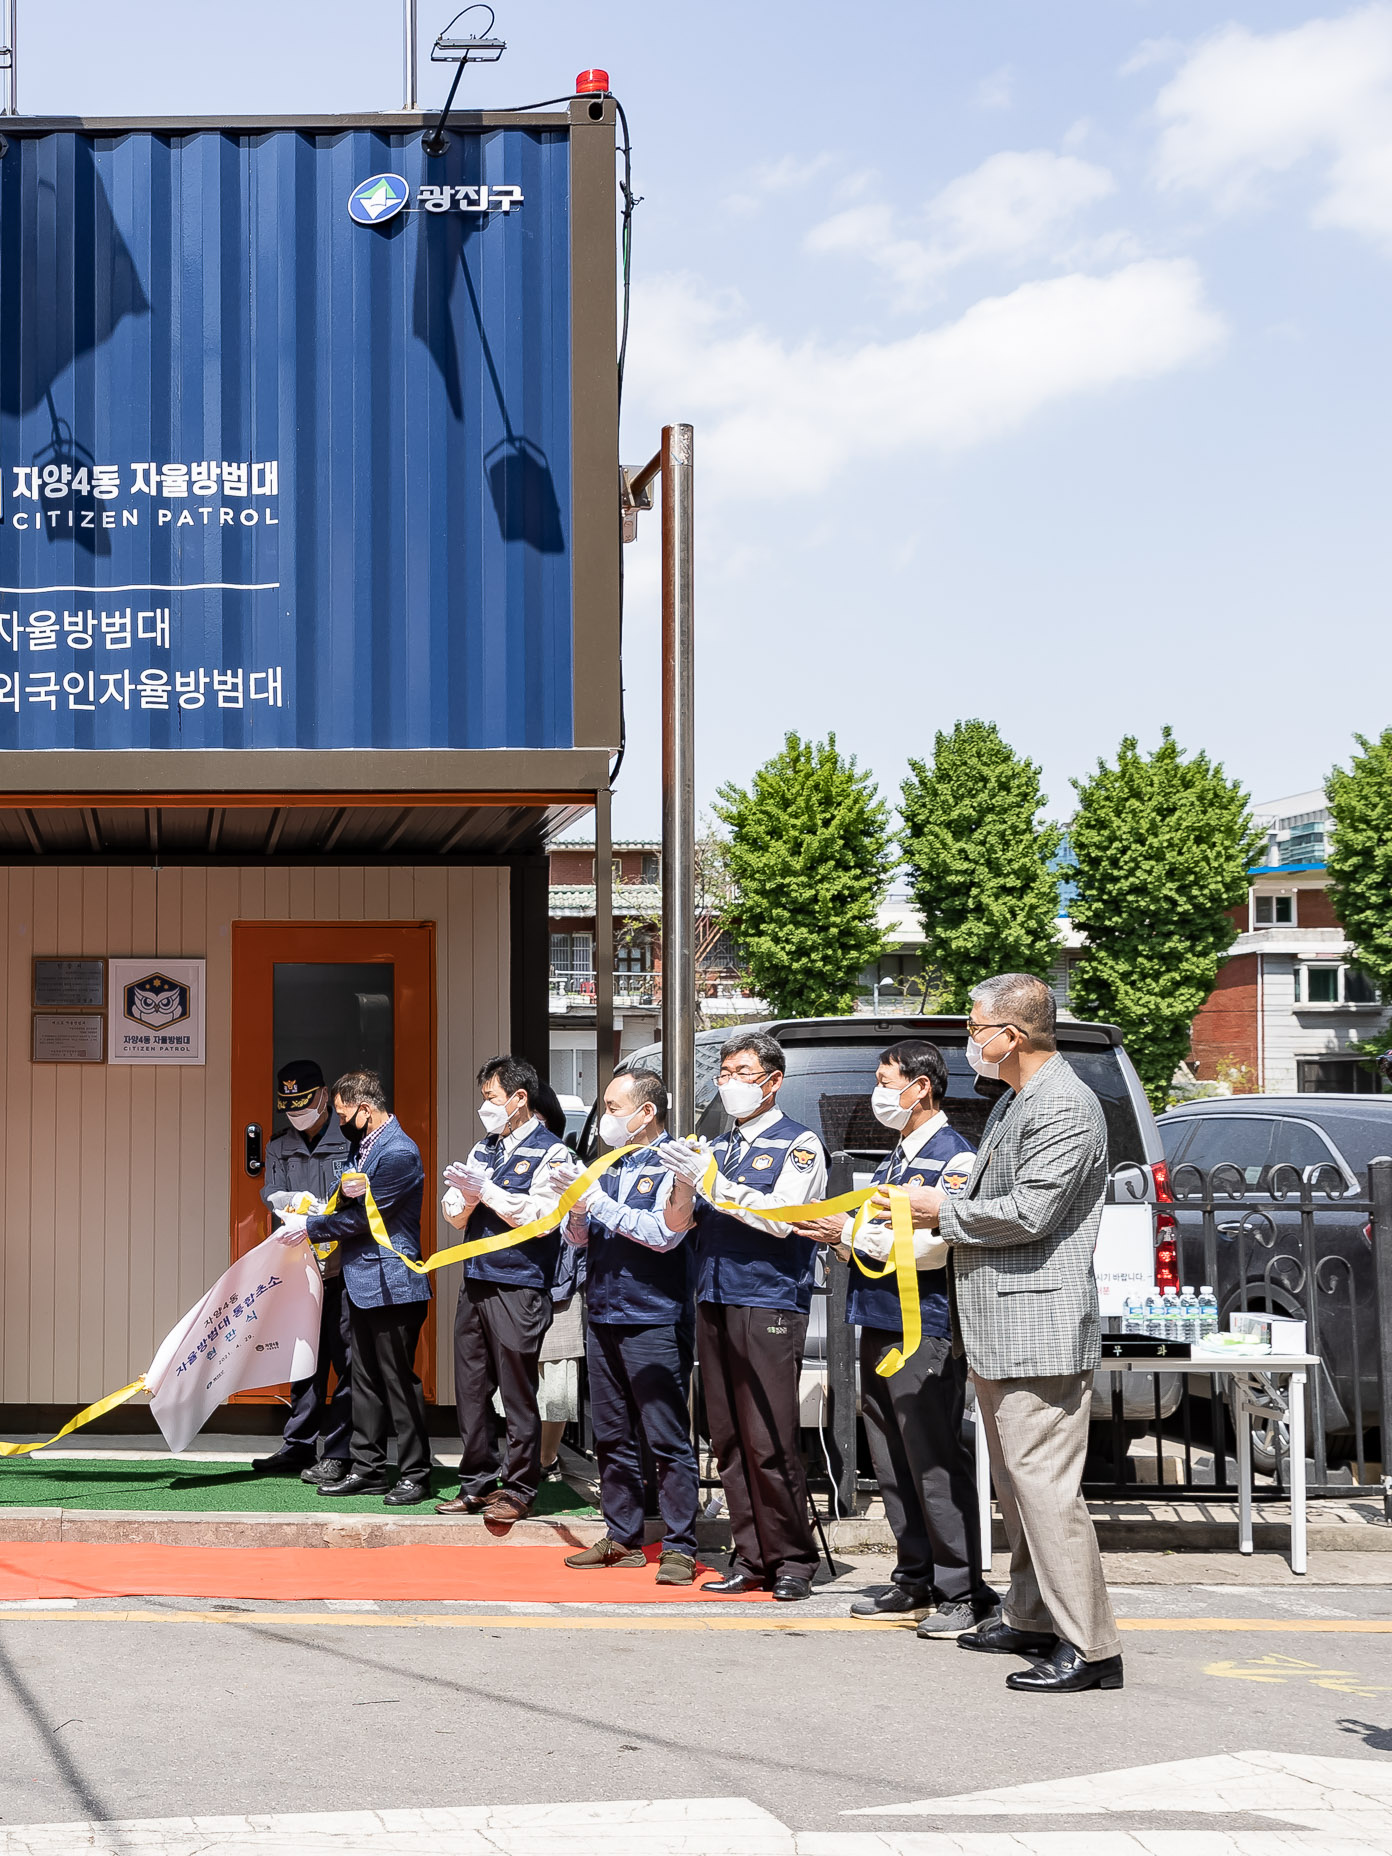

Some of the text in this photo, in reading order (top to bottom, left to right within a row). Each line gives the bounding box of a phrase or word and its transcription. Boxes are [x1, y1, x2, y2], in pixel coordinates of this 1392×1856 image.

[417, 185, 524, 213] 광진구
[12, 460, 279, 500] 자양4동 자율방범대
[12, 507, 279, 531] CITIZEN PATROL
[123, 1035, 191, 1045] 자양4동 자율방범대
[175, 1276, 283, 1377] 자율방범대 통합초소
[204, 1293, 239, 1329] 자양4동
